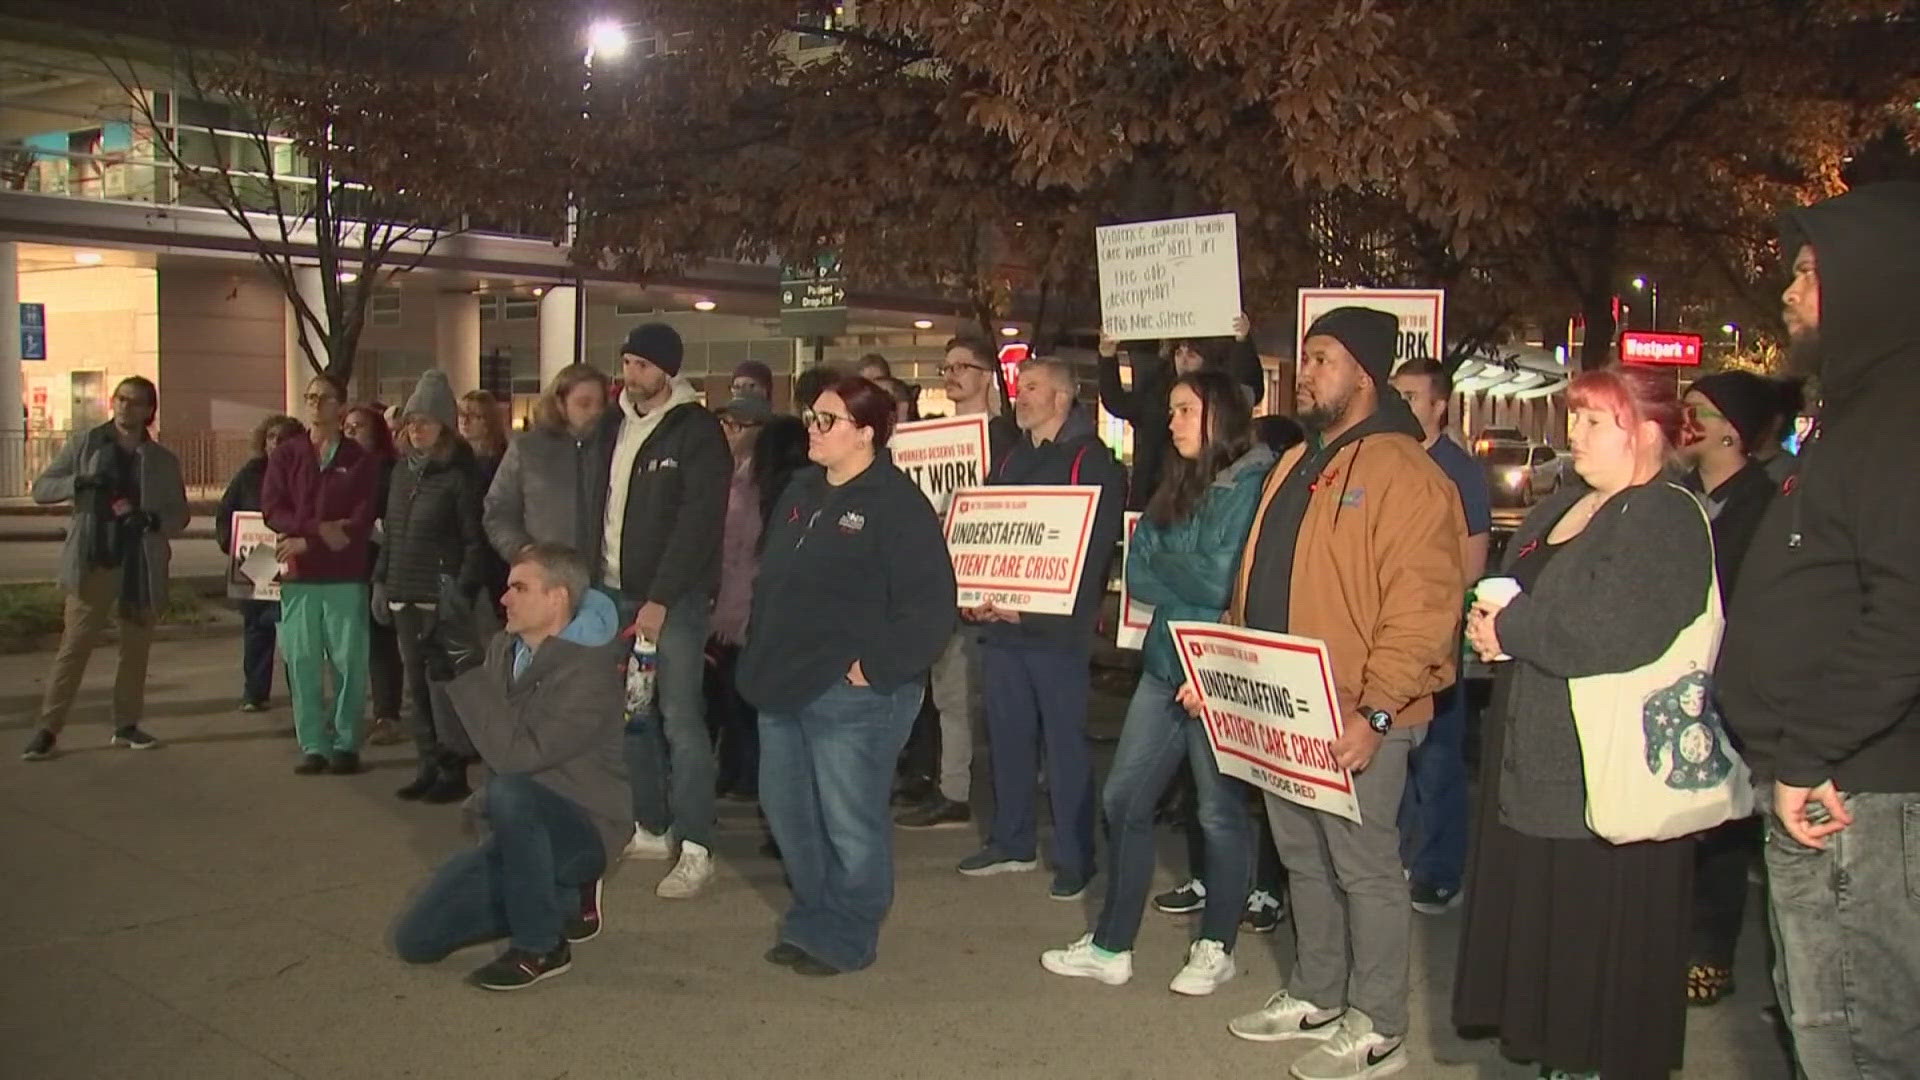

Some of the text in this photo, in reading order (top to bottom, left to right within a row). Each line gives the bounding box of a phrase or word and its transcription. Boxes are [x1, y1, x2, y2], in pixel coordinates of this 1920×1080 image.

[1394, 330, 1429, 360] ORK
[1626, 339, 1682, 359] Westpark
[928, 460, 978, 494] WORK
[951, 521, 1045, 546] UNDERSTAFFING
[990, 554, 1025, 579] CARE
[1025, 556, 1070, 581] CRISIS
[983, 591, 1009, 603] CODE
[1010, 593, 1031, 605] RED
[1198, 668, 1296, 719] UNDERSTAFFING
[1212, 710, 1340, 773] PATIENT CARE CRISIS
[1267, 773, 1294, 794] CODE
[1293, 782, 1317, 800] RED
